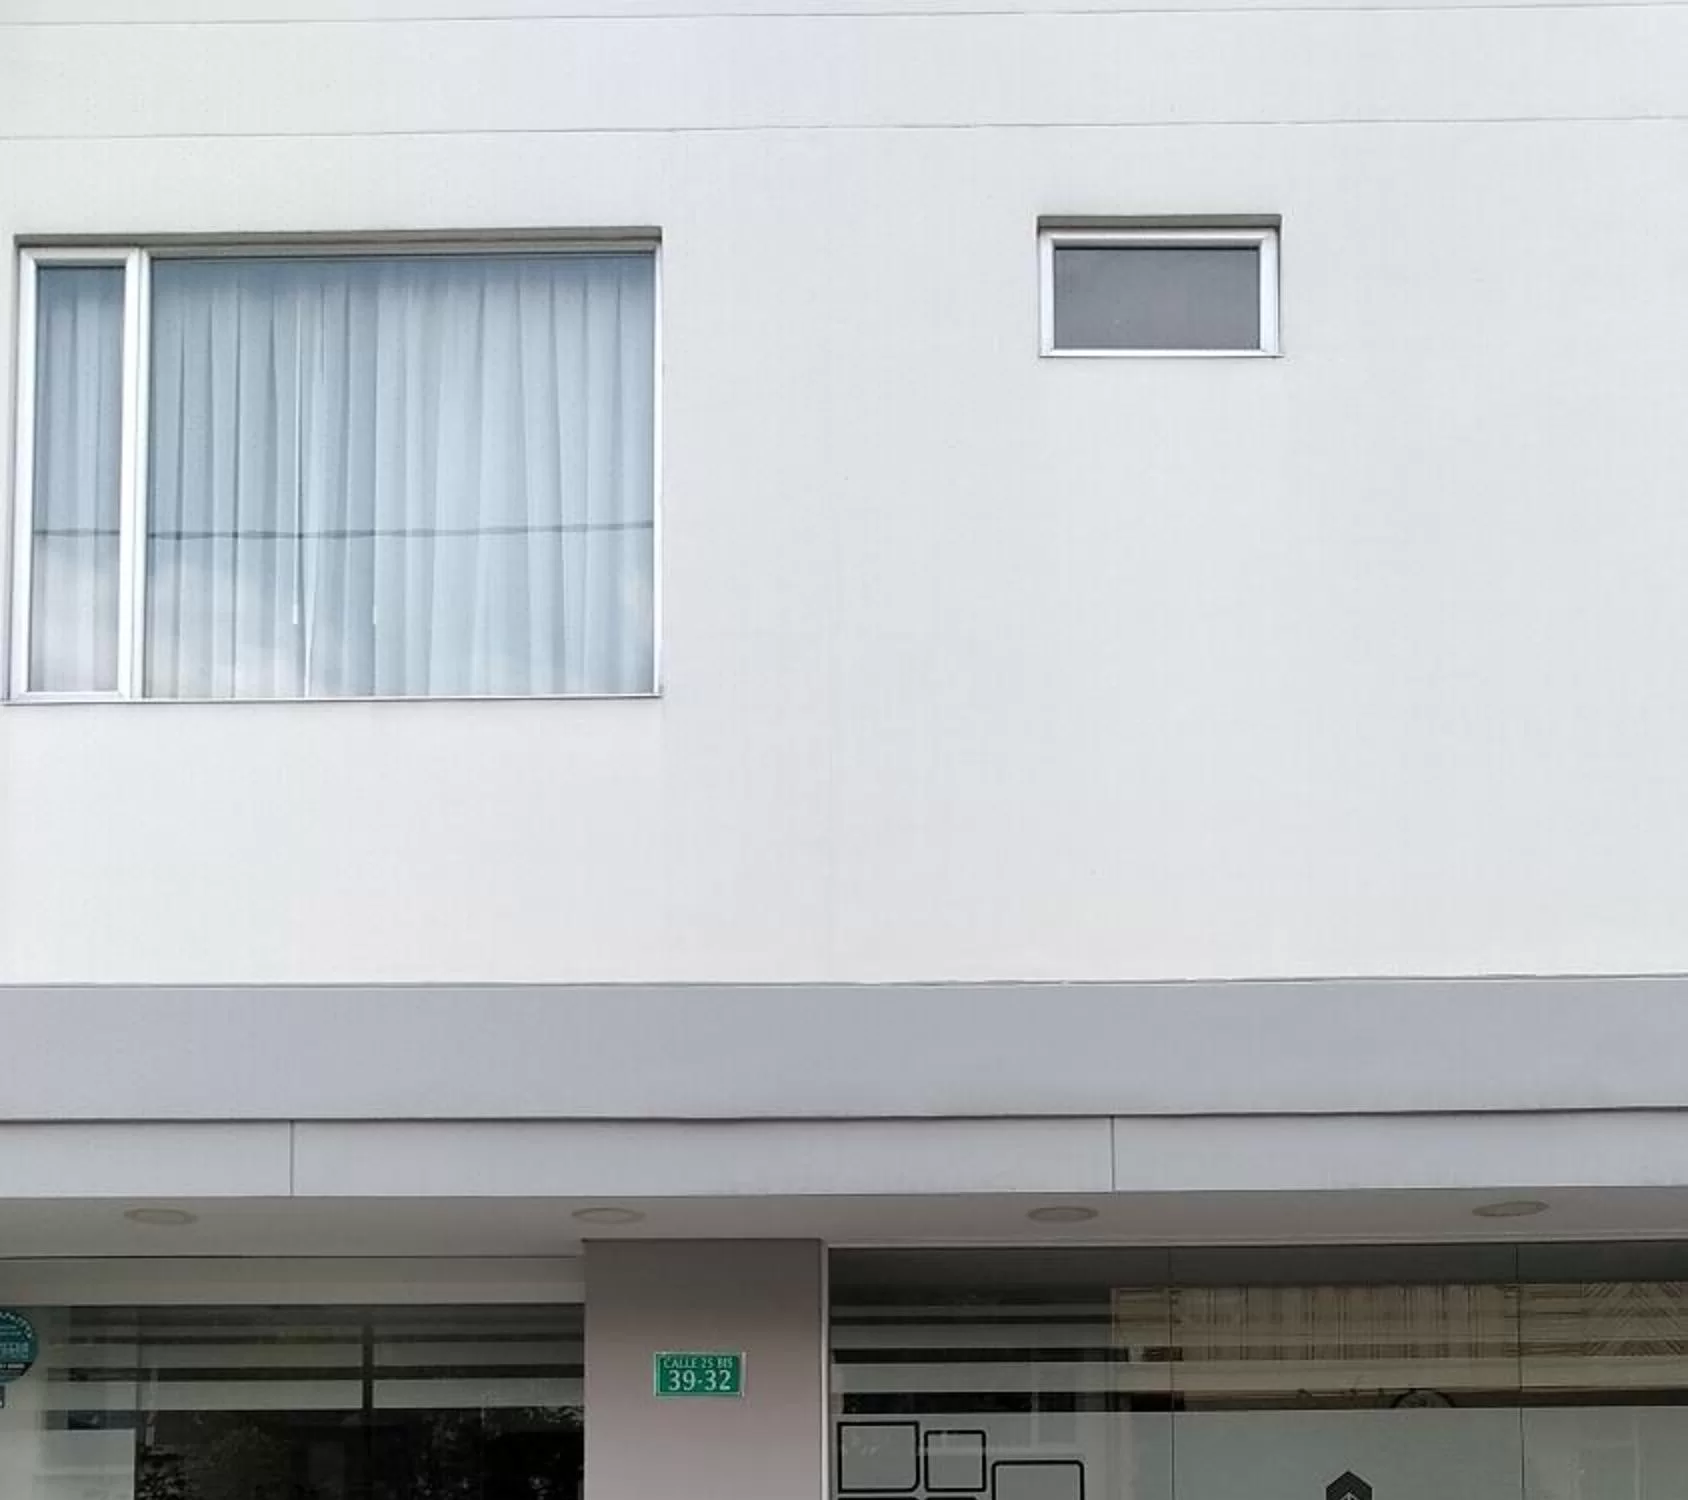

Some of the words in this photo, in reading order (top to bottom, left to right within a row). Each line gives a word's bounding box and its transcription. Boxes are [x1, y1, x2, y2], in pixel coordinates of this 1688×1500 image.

[663, 1357, 697, 1369] CALLE
[701, 1357, 713, 1369] 25
[717, 1357, 733, 1369] BIS
[668, 1369, 731, 1391] 39-32
